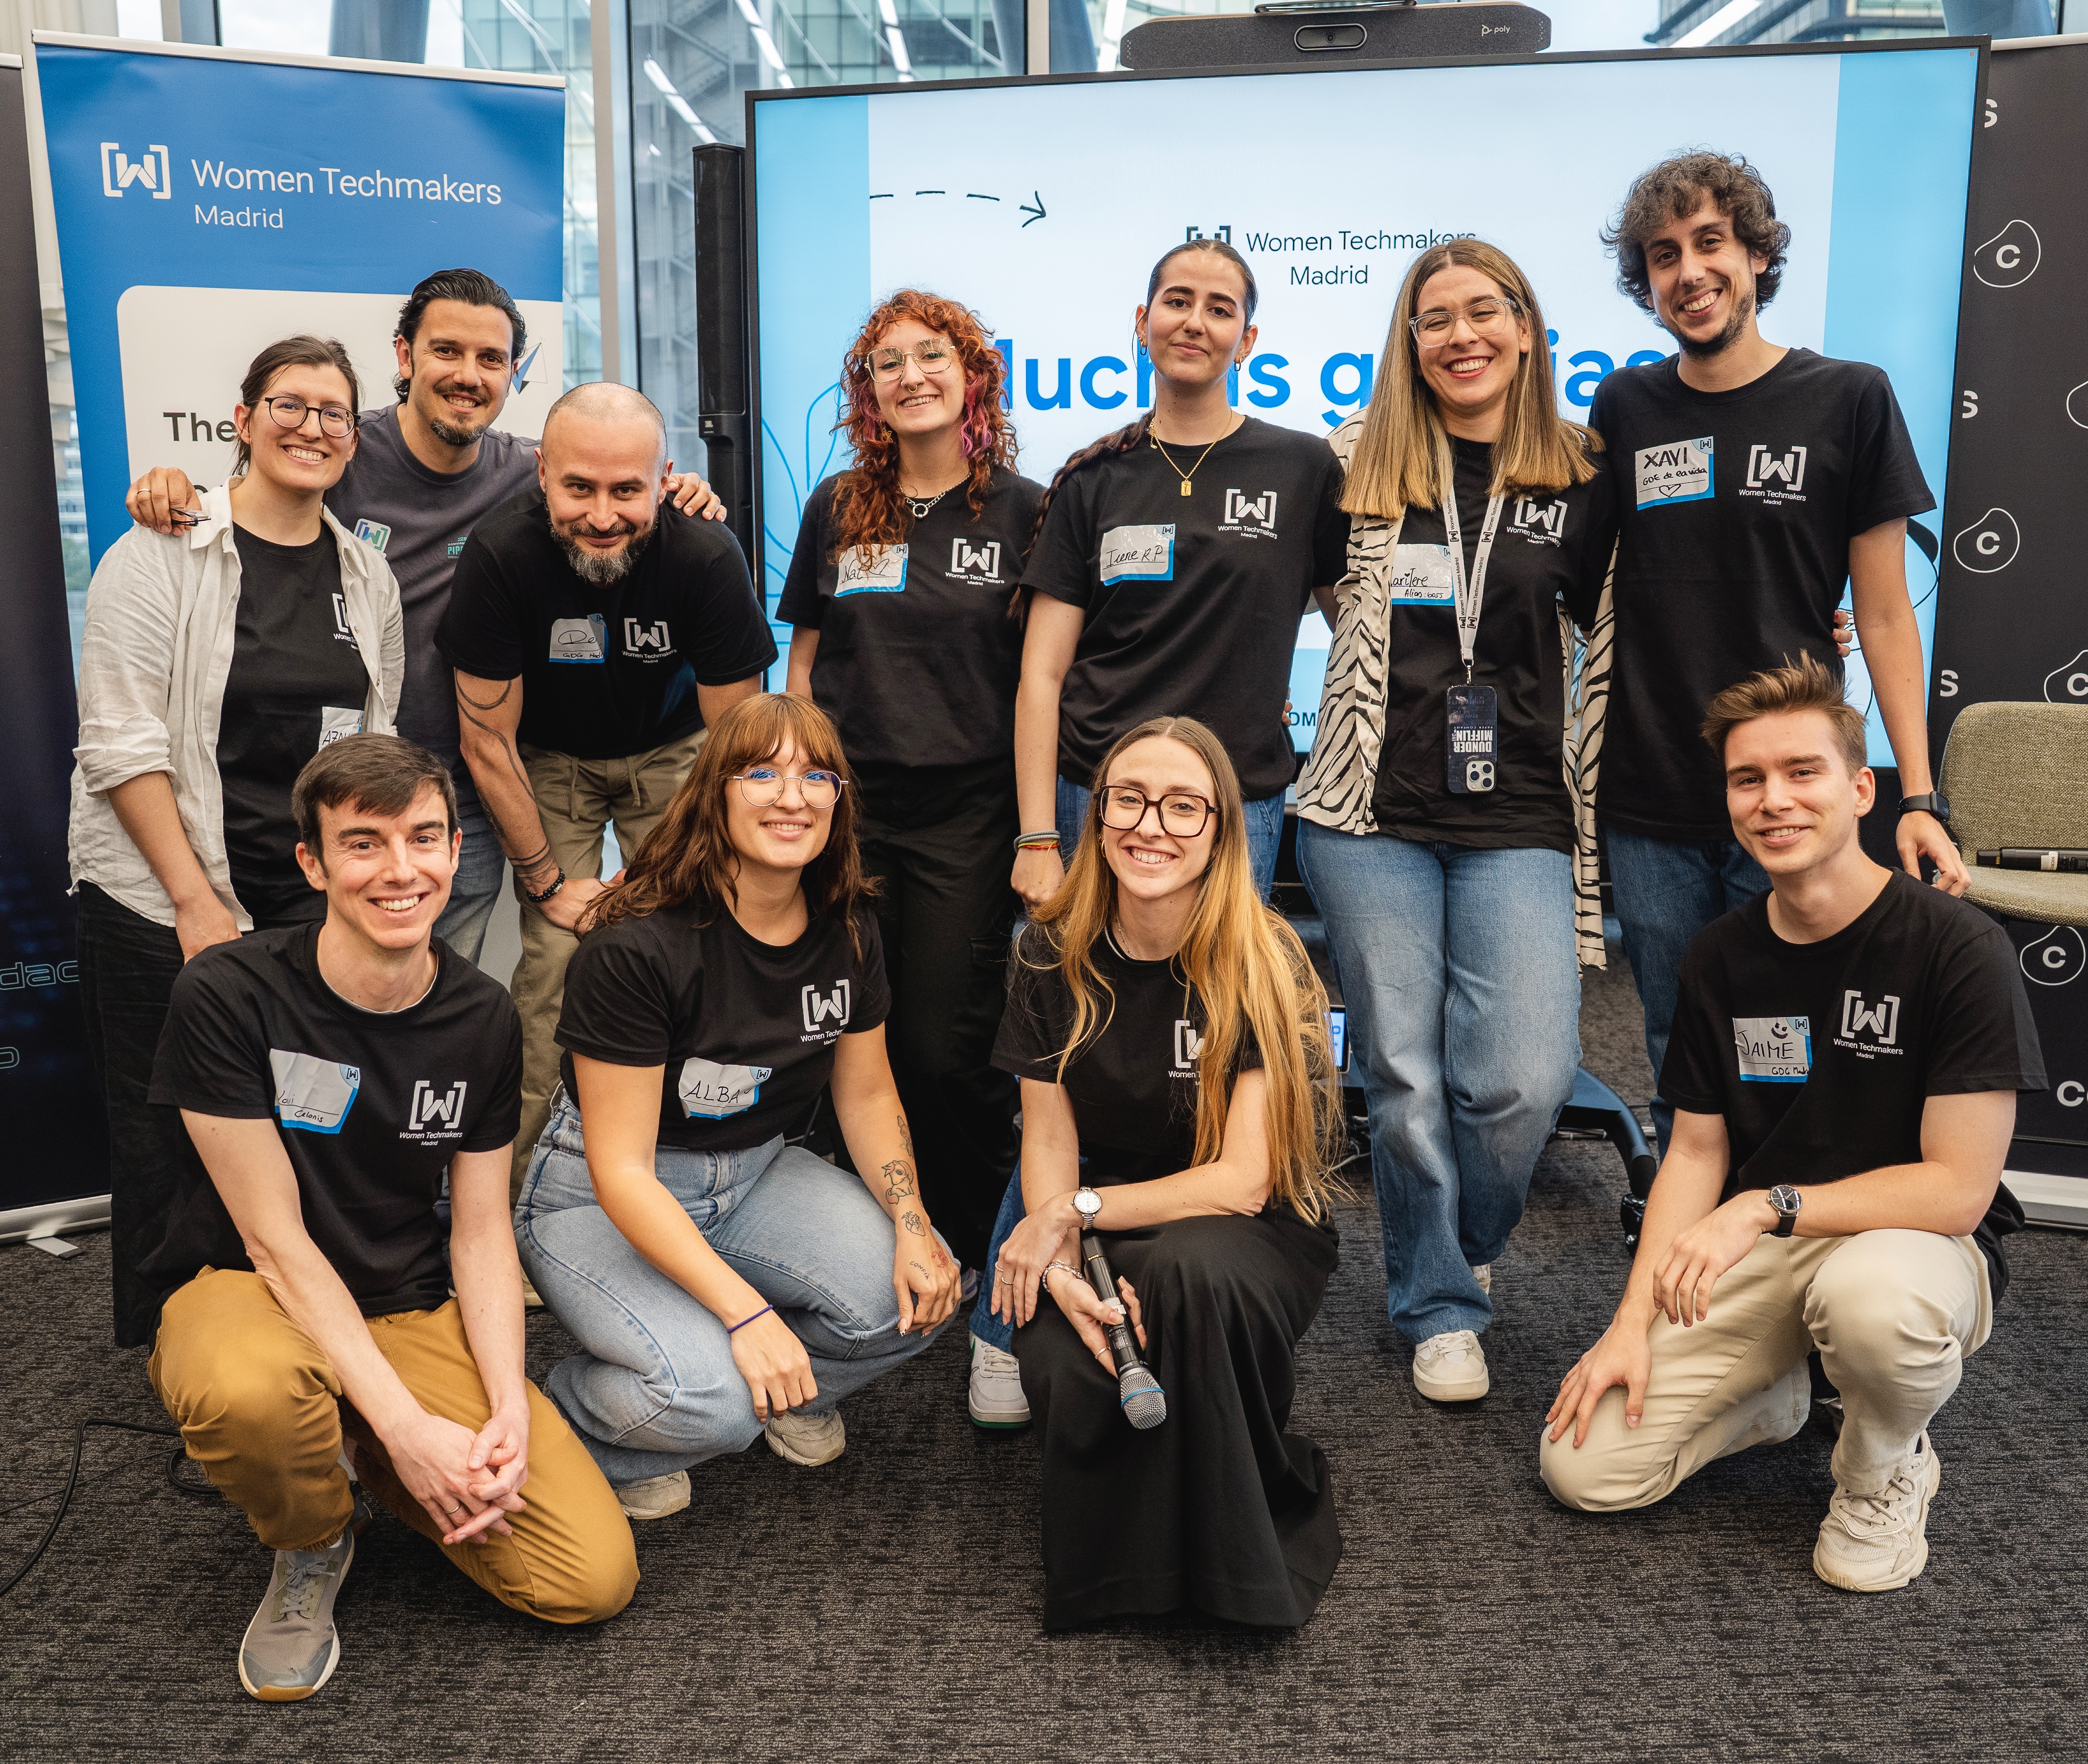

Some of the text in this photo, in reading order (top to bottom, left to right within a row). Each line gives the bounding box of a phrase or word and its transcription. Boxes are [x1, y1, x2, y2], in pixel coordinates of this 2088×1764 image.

[1494, 25, 1511, 34] poly
[191, 159, 502, 205] Women Techmakers
[195, 204, 284, 228] Madrid
[1246, 232, 1332, 252] Women
[1290, 266, 1368, 285] Madrid
[163, 412, 237, 442] The
[1643, 447, 1687, 469] XAVI
[1766, 490, 1806, 501] Techmakers
[1243, 525, 1278, 539] Techmakers
[1507, 526, 1530, 536] Women
[969, 574, 1005, 584] Techmakers
[644, 649, 677, 659] Techmakers
[1454, 741, 1492, 753] DUNDER
[801, 1034, 825, 1042] Women
[1737, 1030, 1795, 1059] JAIME
[1833, 1038, 1903, 1055] Women Techmakers
[1772, 1067, 1790, 1075] GDG
[295, 1110, 323, 1122] Celonis
